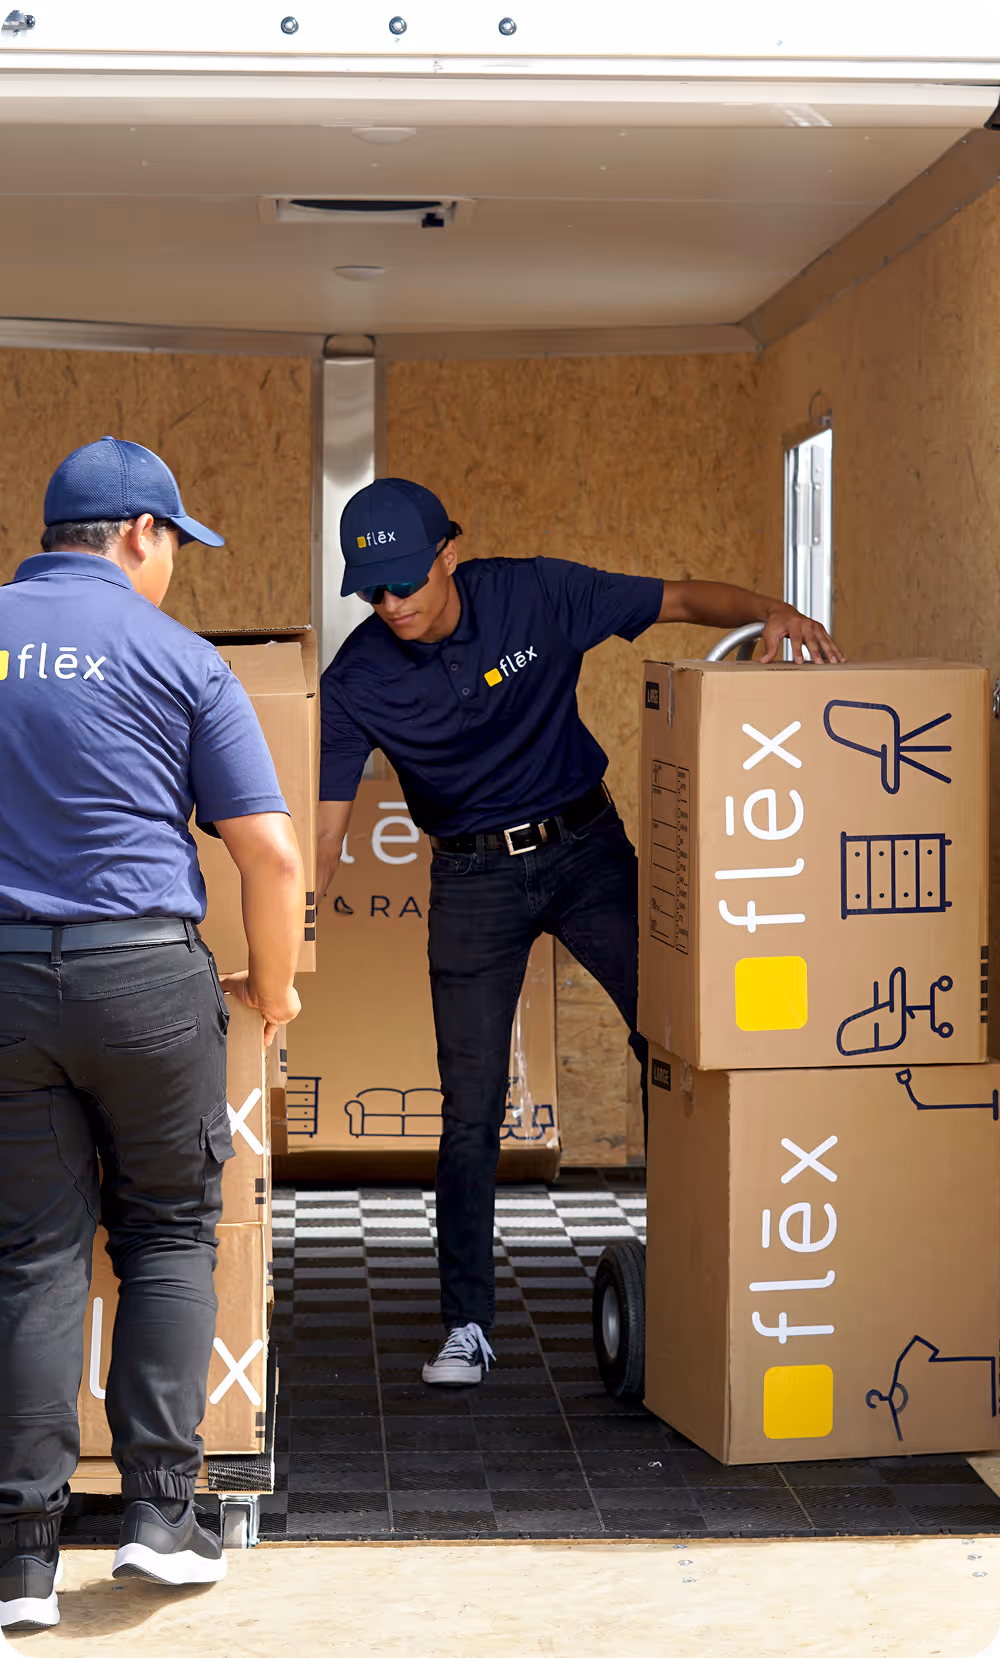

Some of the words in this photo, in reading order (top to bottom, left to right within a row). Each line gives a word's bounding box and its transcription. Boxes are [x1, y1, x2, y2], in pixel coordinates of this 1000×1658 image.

[365, 530, 397, 547] flēx
[17, 642, 107, 681] flēx
[499, 645, 538, 677] flēx
[714, 720, 806, 934] flēx
[748, 1135, 838, 1344] flēx
